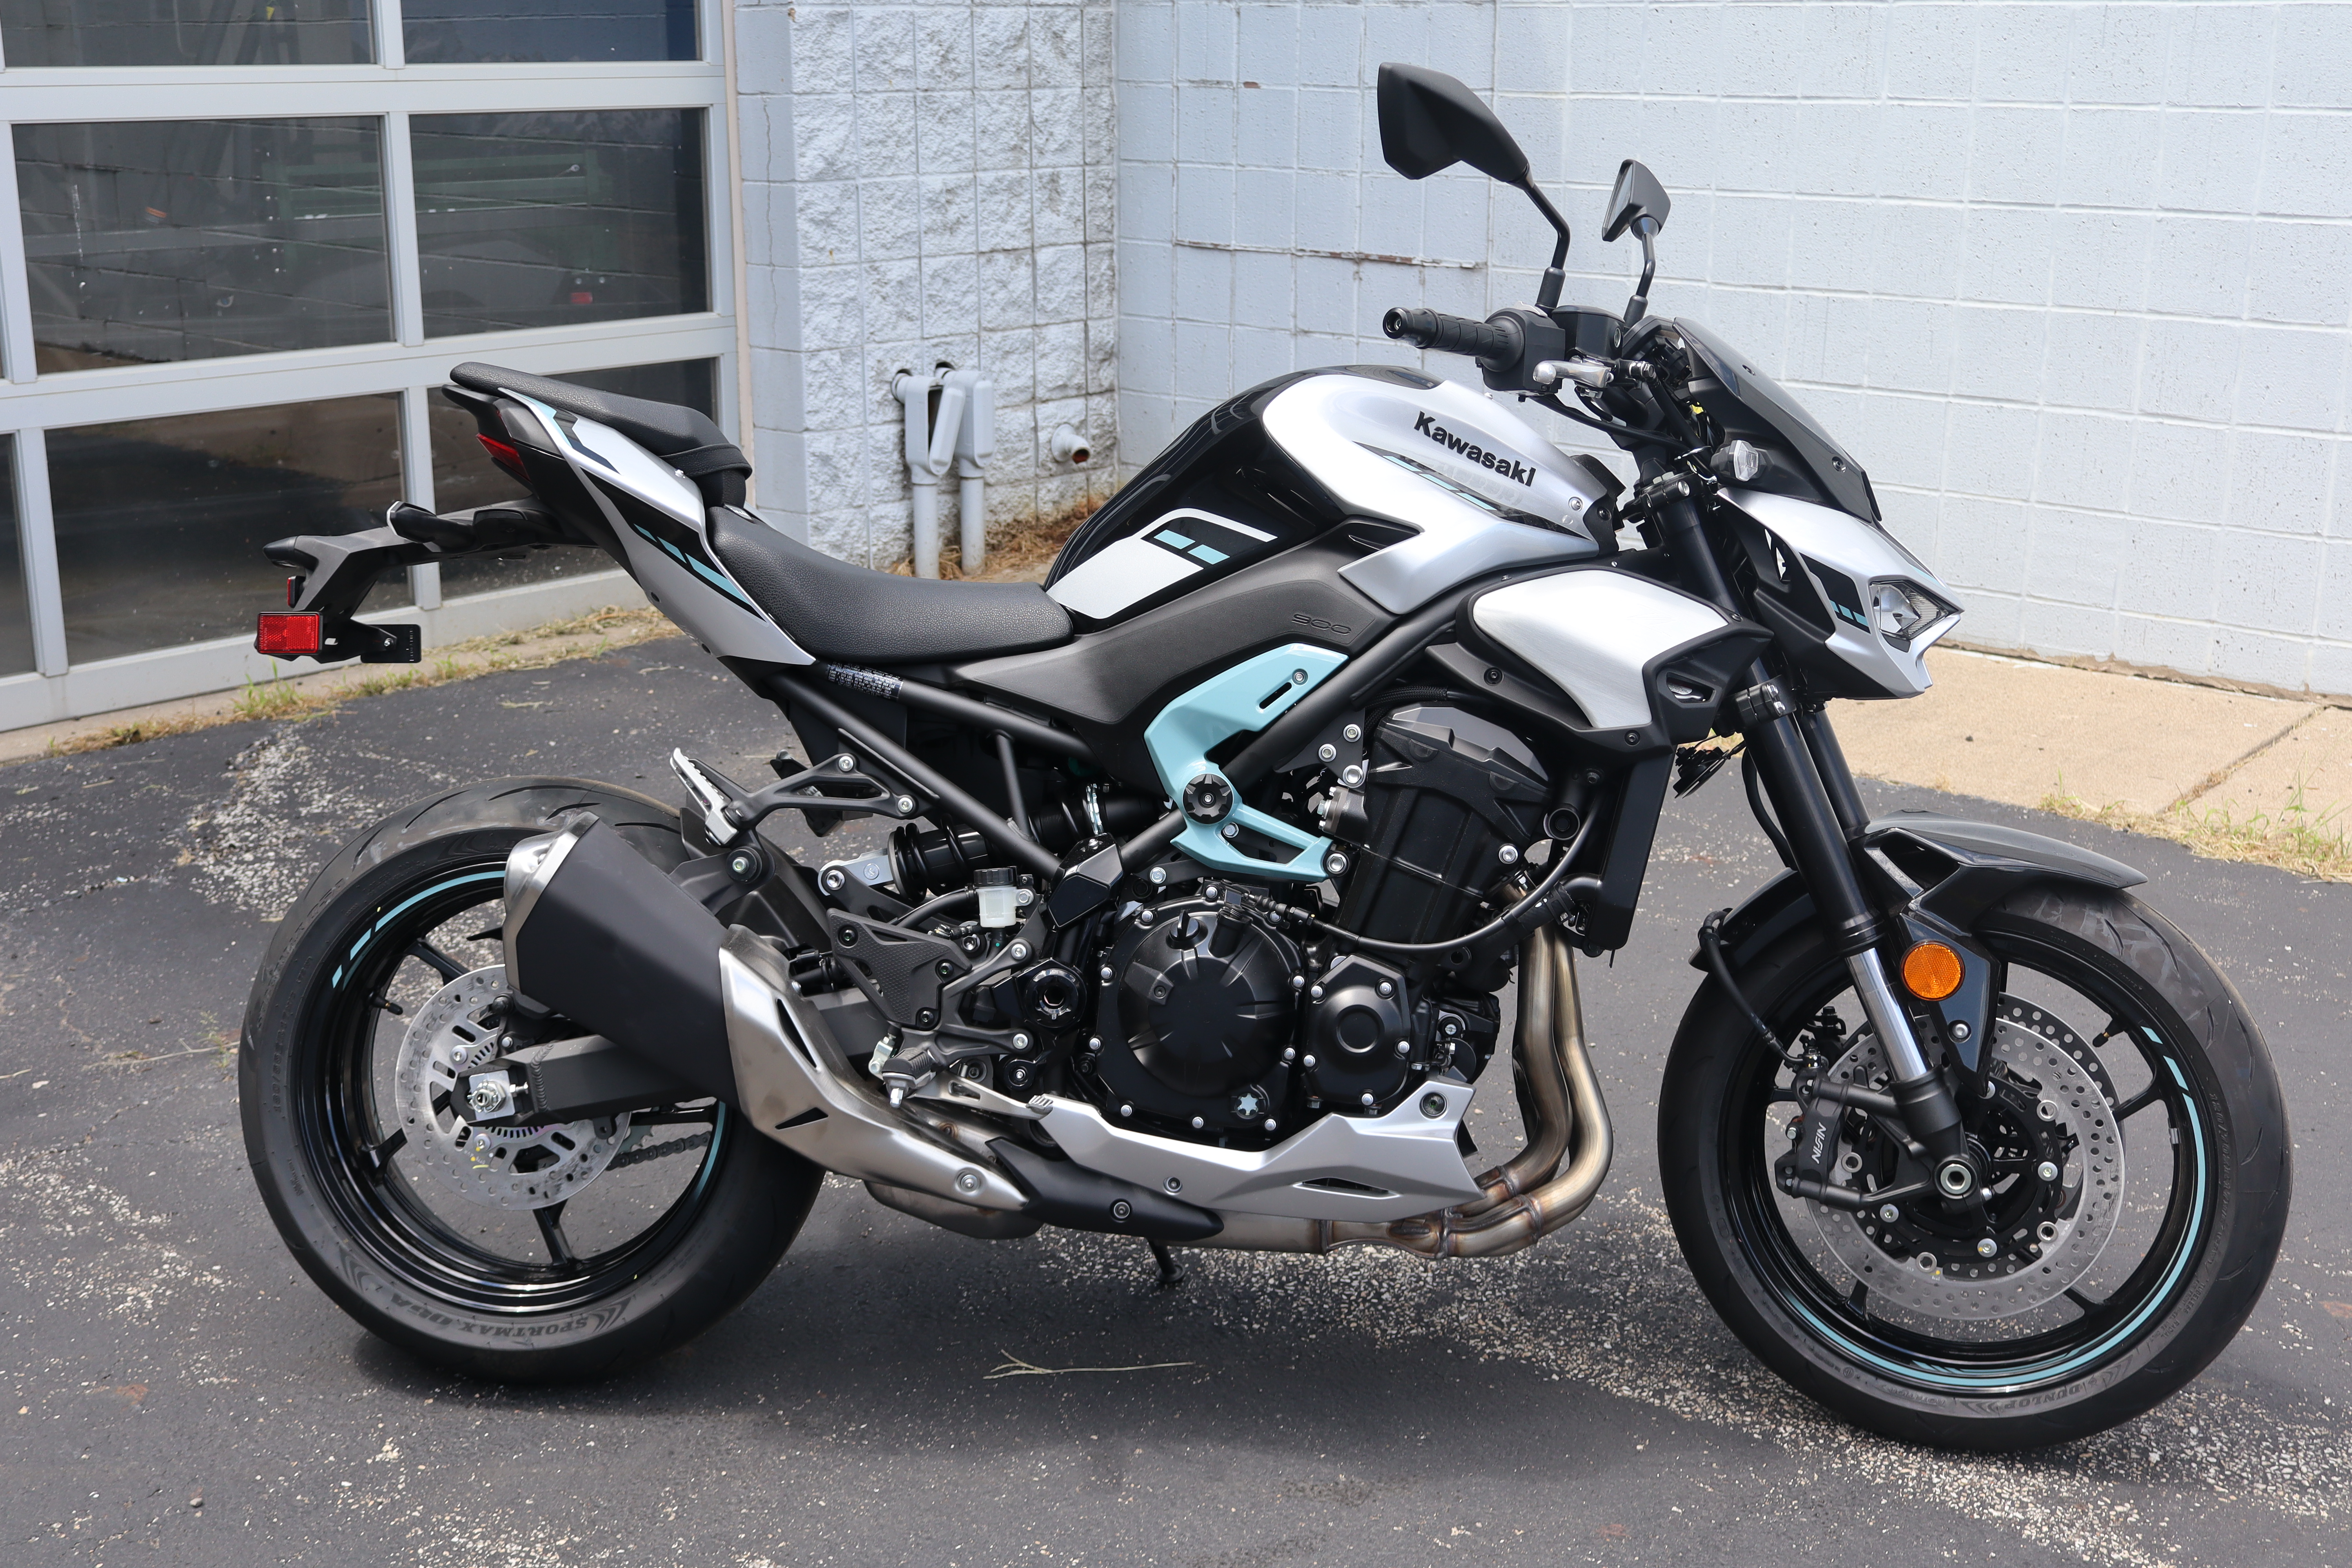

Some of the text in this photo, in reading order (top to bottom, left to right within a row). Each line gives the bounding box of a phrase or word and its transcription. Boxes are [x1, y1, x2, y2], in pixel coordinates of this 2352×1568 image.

[1414, 410, 1536, 487] Kawasaki
[1292, 613, 1352, 635] 900
[1811, 1122, 1827, 1164] NISSIN
[459, 1318, 588, 1337] SPORTMAX
[2162, 1319, 2180, 1340] RADIAL
[2004, 1384, 2080, 1410] DUNLOP
